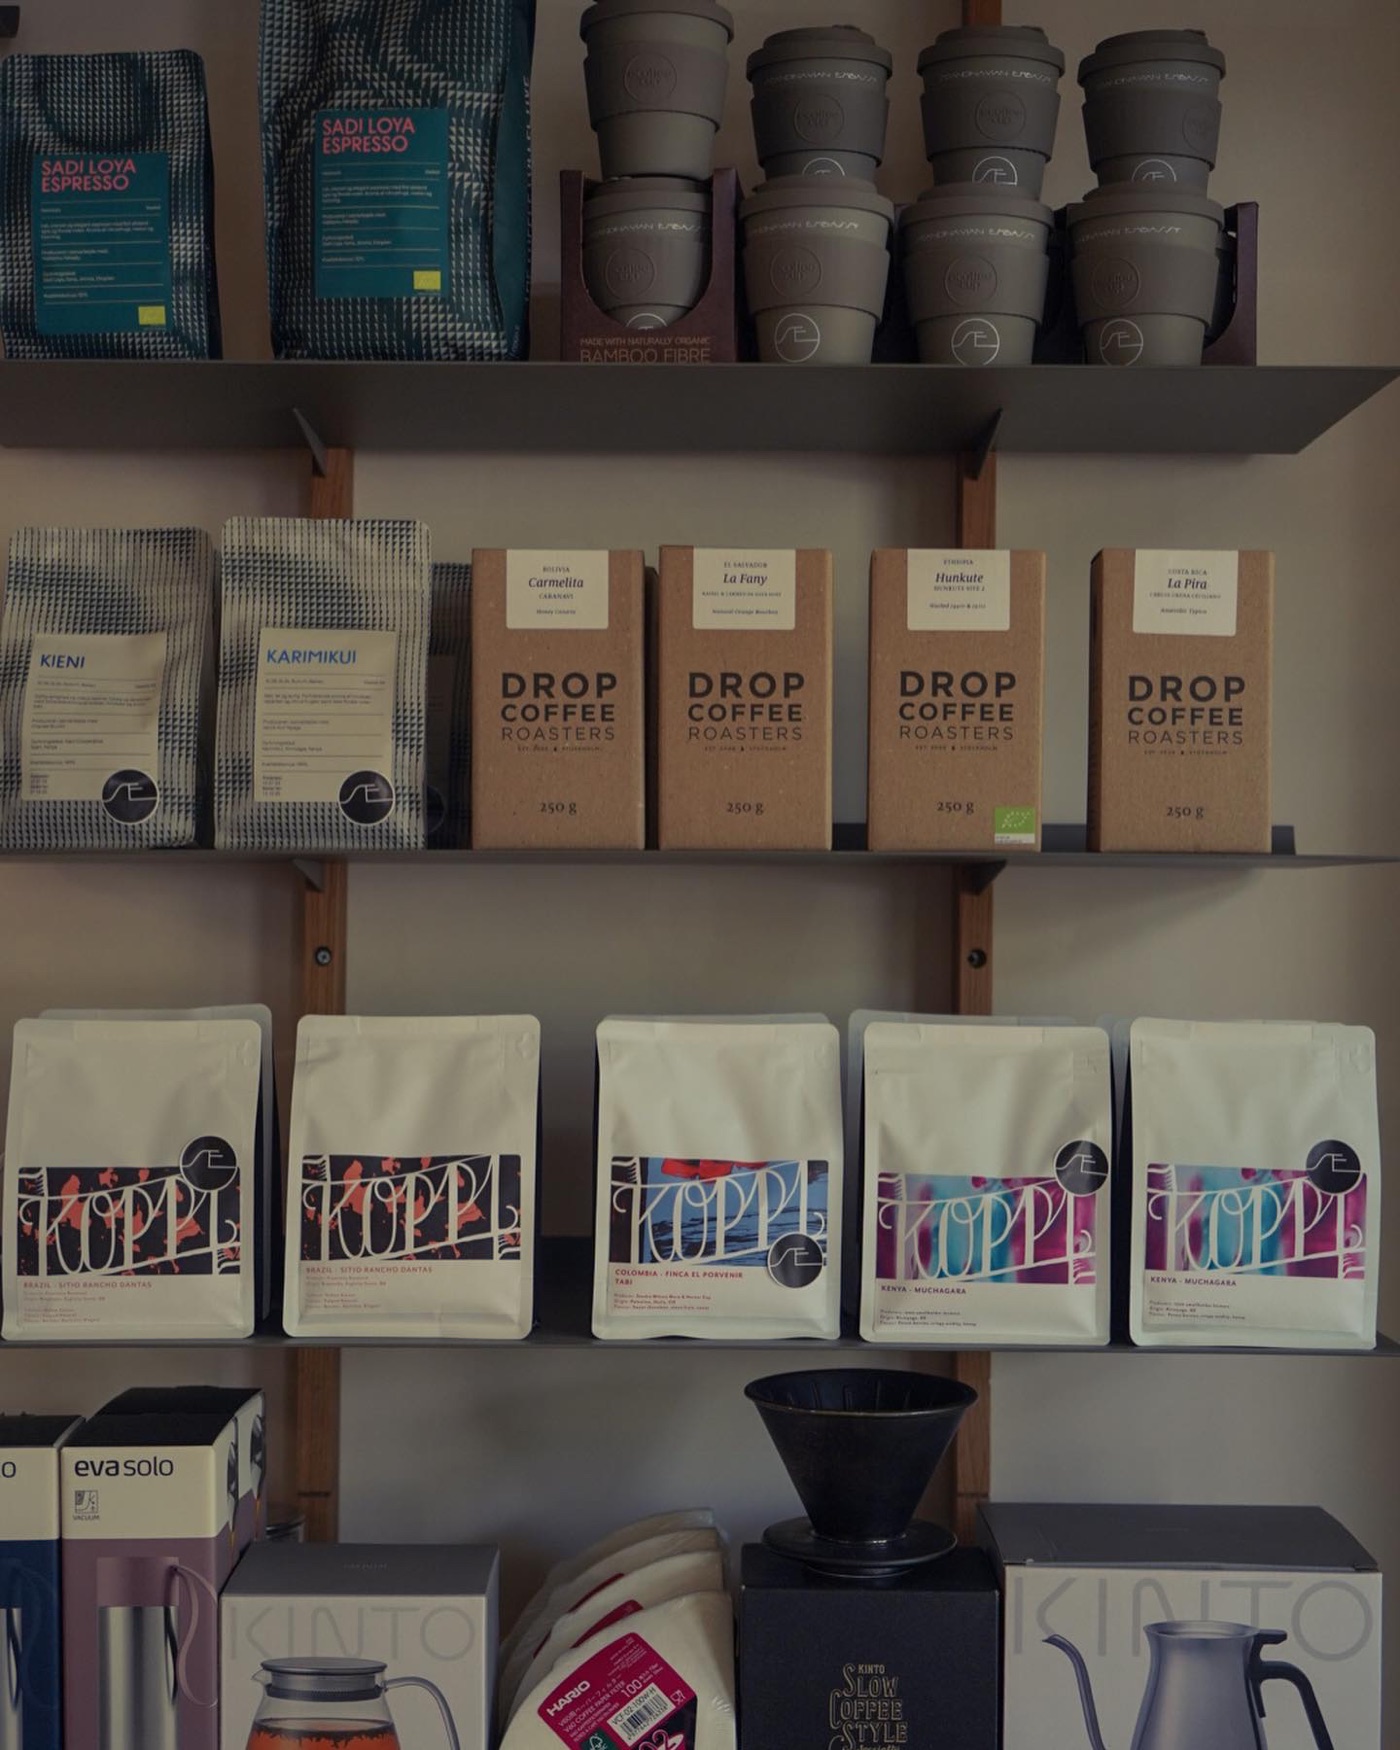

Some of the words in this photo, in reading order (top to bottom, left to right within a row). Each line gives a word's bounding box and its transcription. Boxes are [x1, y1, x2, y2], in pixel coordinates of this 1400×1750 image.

[322, 118, 363, 136] SADI
[368, 116, 415, 134] LOYA
[322, 135, 409, 154] ESPRESSO
[41, 159, 84, 176] SADI
[89, 158, 137, 174] LOYA
[41, 175, 130, 193] ESPRESSO
[580, 337, 601, 346] MADE
[605, 337, 626, 345] WITH
[628, 336, 671, 345] NATURALLY
[675, 336, 710, 345] ORGANIC
[580, 348, 658, 363] BAMBOO
[664, 348, 711, 363] FIBRE
[528, 577, 584, 588] Carmelita
[723, 574, 736, 584] La
[740, 574, 767, 586] Fany
[935, 572, 984, 583] Hunkute
[1168, 578, 1181, 589] La
[1184, 578, 1207, 589] Pira
[39, 654, 85, 668] KIENI
[266, 649, 356, 665] KARIMIKUI
[501, 673, 617, 699] DROP
[688, 672, 804, 699] DROP
[900, 671, 1016, 698] DROP
[1128, 676, 1245, 702] DROP
[501, 704, 615, 722] COFFEE
[688, 704, 802, 722] COFFEE
[899, 703, 1013, 721] COFFEE
[1128, 707, 1243, 726] COFFEE
[501, 727, 615, 741] ROASTERS
[688, 726, 802, 741] ROASTERS
[899, 725, 1013, 740] ROASTERS
[1128, 730, 1243, 745] ROASTERS
[540, 802, 565, 814] 250
[568, 803, 577, 816] g
[726, 802, 752, 814] 250
[755, 803, 764, 816] g
[936, 801, 962, 813] 250
[966, 801, 974, 815] g
[1166, 806, 1191, 819] 250
[1195, 806, 1204, 820] g
[301, 1155, 521, 1260] KOPPI
[615, 1269, 658, 1277] COLOMBIA
[702, 1271, 743, 1279] PORVENIR
[1184, 1278, 1237, 1287] MUCHAGARA
[914, 1287, 967, 1295] MUCHAGARA
[1014, 1577, 1373, 1661] KINTO
[229, 1605, 475, 1661] KINTO
[858, 1664, 885, 1674] KINTO
[621, 1679, 643, 1698] 100
[842, 1663, 899, 1698] SLOW
[545, 1680, 591, 1717] HARIO
[829, 1688, 903, 1730] COFFEE
[842, 1720, 908, 1750] STYLE
